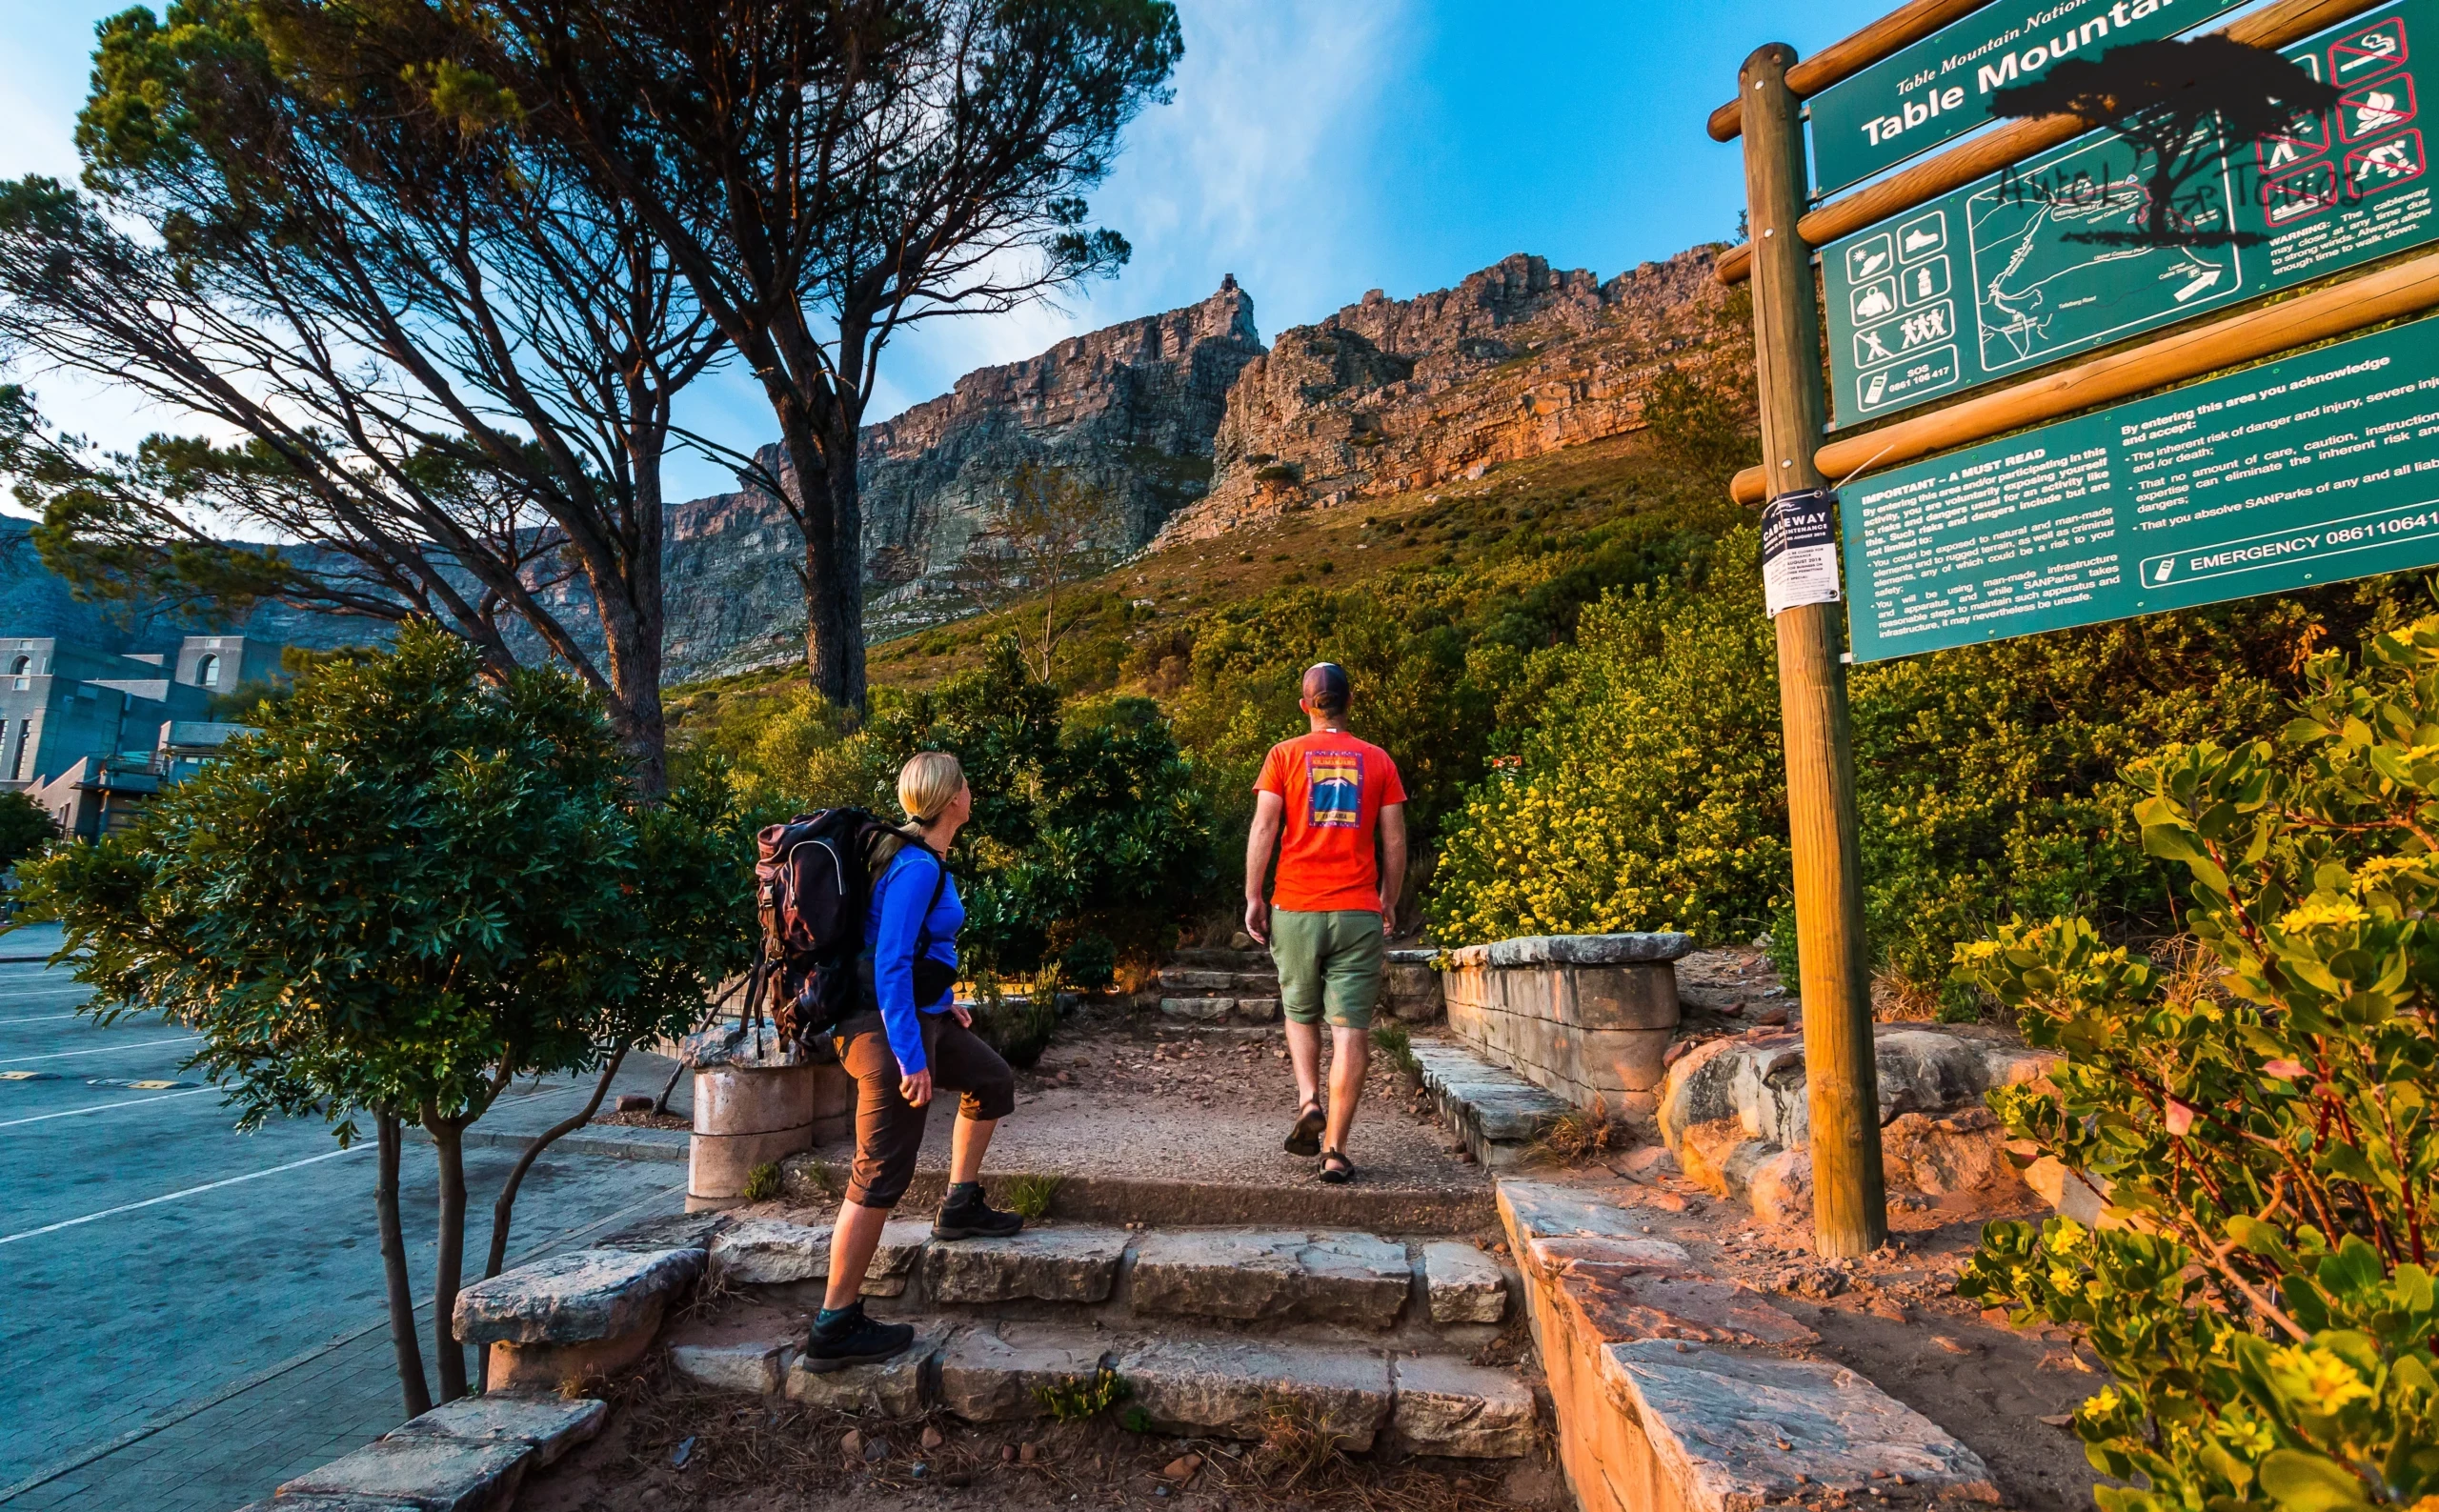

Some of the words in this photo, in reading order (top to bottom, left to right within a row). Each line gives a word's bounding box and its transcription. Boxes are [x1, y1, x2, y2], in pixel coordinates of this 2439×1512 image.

[1860, 86, 1965, 147] Table
[1977, 0, 2173, 95] Mounta
[1896, 71, 1936, 97] Table
[1940, 30, 2021, 75] Mountain
[2268, 221, 2331, 247] WARNING:
[2340, 211, 2364, 222] The
[2373, 188, 2429, 212] cableway
[2270, 244, 2293, 256] may
[2298, 232, 2328, 247] close
[2332, 226, 2345, 235] at
[2349, 218, 2370, 230] any
[2375, 208, 2402, 221] time
[2407, 195, 2430, 211] due
[2284, 246, 2319, 262] strong
[2319, 234, 2355, 250] winds.
[2357, 219, 2399, 237] Always
[2400, 208, 2432, 223] allow
[2272, 253, 2313, 275] enough
[2314, 249, 2340, 261] time
[2341, 244, 2353, 252] to
[2355, 234, 2383, 248] walk
[2384, 223, 2420, 239] down.
[1888, 379, 1911, 393] 0861
[1913, 373, 1931, 384] 106
[1931, 366, 1949, 377] 417
[1906, 364, 1929, 377] SOS
[2121, 424, 2139, 435] By
[2141, 410, 2195, 430] entering
[2196, 402, 2224, 414] this
[2226, 393, 2257, 408] area
[2259, 385, 2287, 400] you
[2289, 356, 2390, 391] acknowledge
[2122, 433, 2147, 446] and
[2148, 418, 2197, 439] accept:
[2131, 451, 2154, 461] The
[2156, 436, 2205, 455] inherent
[2207, 431, 2229, 443] risk
[2230, 426, 2244, 437] of
[2246, 415, 2291, 433] danger
[2294, 407, 2320, 421] and
[2322, 398, 2363, 413] injury,
[2366, 384, 2415, 403] severe
[1862, 477, 1936, 505] IMPORTANT
[1948, 472, 1959, 482] A
[1962, 459, 2002, 478] MUST
[2005, 449, 2046, 467] READ
[1863, 508, 1876, 517] By
[1877, 497, 1917, 514] entering
[1918, 492, 1938, 502] this
[1938, 486, 1962, 497] area
[1962, 476, 1997, 491] and/or
[1998, 457, 2068, 483] participating
[2069, 454, 2082, 463] in
[2083, 448, 2106, 459] this
[2132, 460, 2155, 474] and
[2157, 457, 2173, 467] /or
[2176, 448, 2214, 462] death;
[2136, 484, 2189, 502] expertise
[2195, 477, 2219, 489] can
[2225, 462, 2283, 481] eliminate
[2289, 456, 2311, 467] the
[2319, 439, 2376, 460] inherent
[2384, 432, 2410, 445] risk
[2418, 426, 2439, 437] an
[2138, 477, 2166, 490] That
[2170, 474, 2187, 483] no
[2192, 459, 2239, 477] amount
[2245, 454, 2258, 465] of
[2264, 448, 2297, 460] care,
[2304, 433, 2358, 451] caution,
[1864, 513, 1900, 527] activity,
[1903, 507, 1923, 518] you
[1925, 502, 1943, 512] are
[1945, 486, 2000, 506] voluntarily
[2004, 473, 2056, 492] exposing
[2059, 456, 2107, 479] yourself
[1865, 537, 1886, 547] this.
[1889, 529, 1915, 541] Such
[1919, 523, 1944, 534] risks
[1946, 515, 1967, 528] and
[1971, 505, 2016, 521] dangers
[2020, 494, 2062, 510] include
[2066, 487, 2086, 498] but
[2090, 482, 2110, 493] are
[1877, 520, 1902, 534] risks
[1904, 515, 1924, 528] and
[1925, 506, 1968, 522] dangers
[1970, 495, 2001, 511] usual
[2003, 493, 2020, 502] for
[2023, 489, 2038, 497] an
[2041, 476, 2084, 494] activity
[2086, 471, 2109, 482] like
[2137, 496, 2188, 514] dangers;
[2139, 518, 2167, 531] That
[2168, 514, 2191, 527] you
[2194, 503, 2243, 519] absolve
[2245, 488, 2313, 509] SANParks
[2315, 482, 2329, 494] of
[2333, 477, 2359, 490] any
[2362, 469, 2390, 483] and
[2393, 464, 2411, 476] all
[1763, 512, 1825, 542] CABLEWAY
[1866, 547, 1883, 557] not
[1884, 538, 1917, 554] limited
[1918, 536, 1933, 545] to:
[1892, 551, 1917, 563] could
[1920, 549, 1932, 557] be
[1935, 537, 1976, 554] exposed
[1992, 526, 2027, 540] natural
[2031, 520, 2051, 532] and
[2055, 507, 2113, 526] man-made
[2190, 534, 2318, 571] EMERGENCY
[2326, 512, 2439, 545] 086110641
[1879, 622, 1940, 638] infrastructure,
[1942, 616, 1948, 627] it
[1949, 615, 1971, 625] may
[1972, 603, 2036, 621] nevertheless
[2053, 593, 2092, 606] unsafe.
